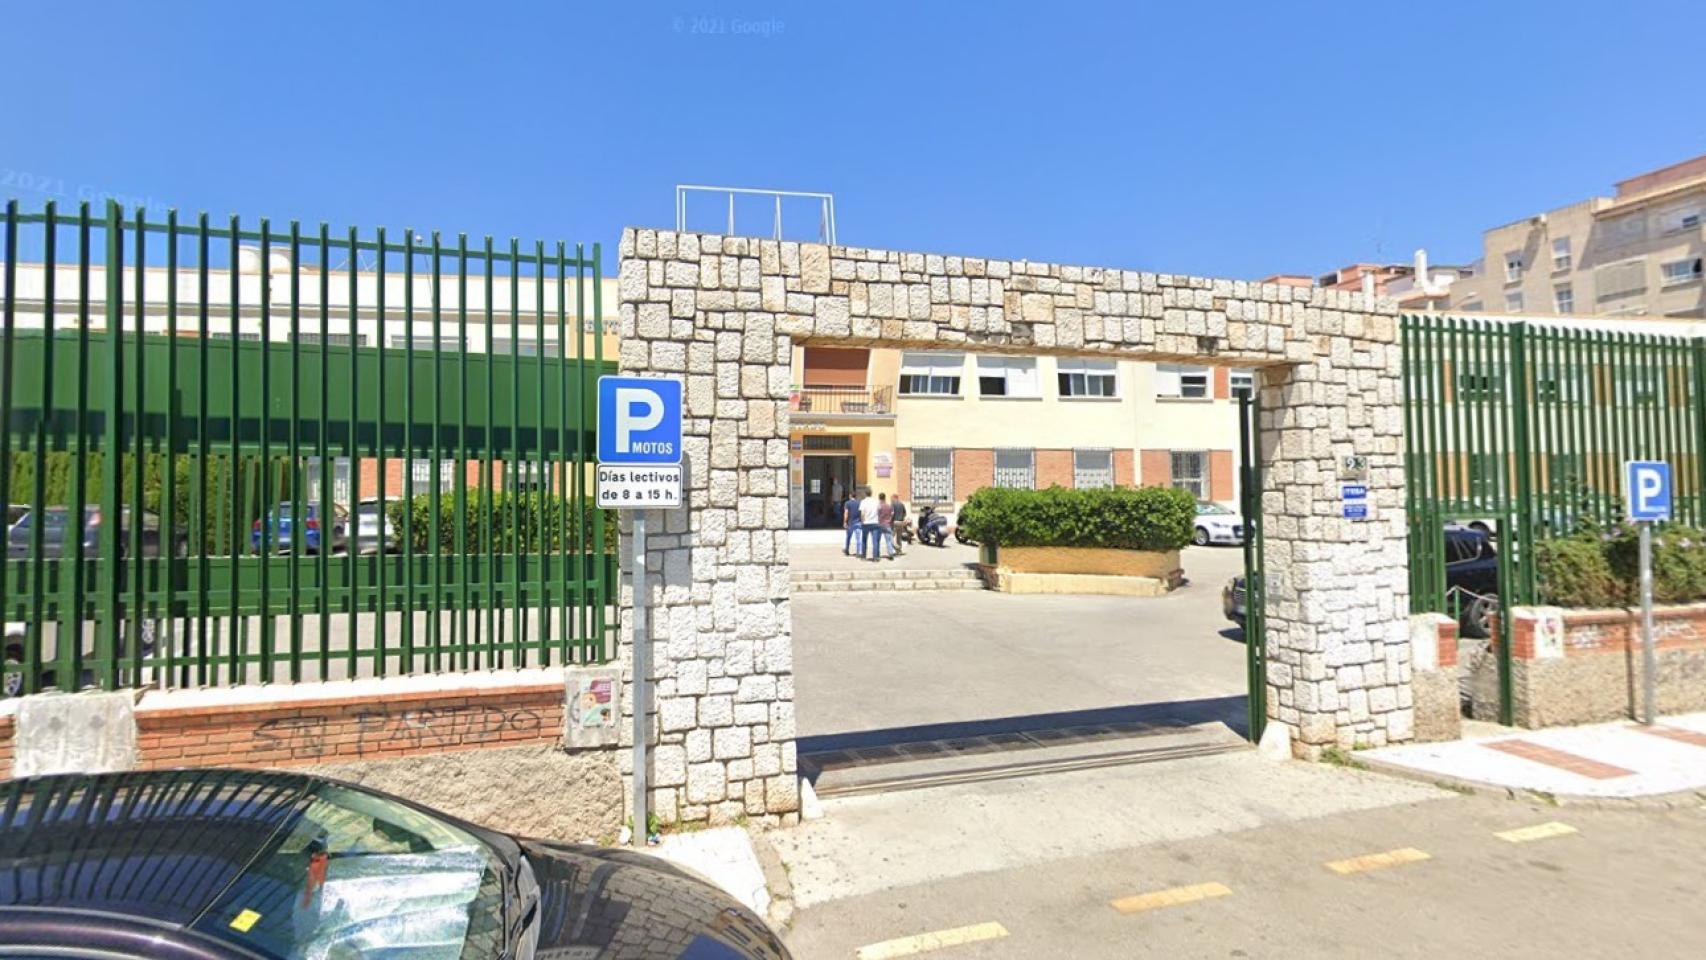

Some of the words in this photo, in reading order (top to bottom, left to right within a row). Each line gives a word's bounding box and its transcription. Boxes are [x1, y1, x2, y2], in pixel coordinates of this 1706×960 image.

[615, 388, 665, 453] P
[632, 441, 673, 455] MOTOS
[599, 471, 626, 483] Días
[630, 471, 680, 483] lectivos
[602, 488, 618, 500] de
[622, 489, 631, 500] 8
[635, 490, 643, 500] a
[648, 489, 660, 500] 15
[664, 488, 678, 500] h.
[1637, 467, 1662, 513] P
